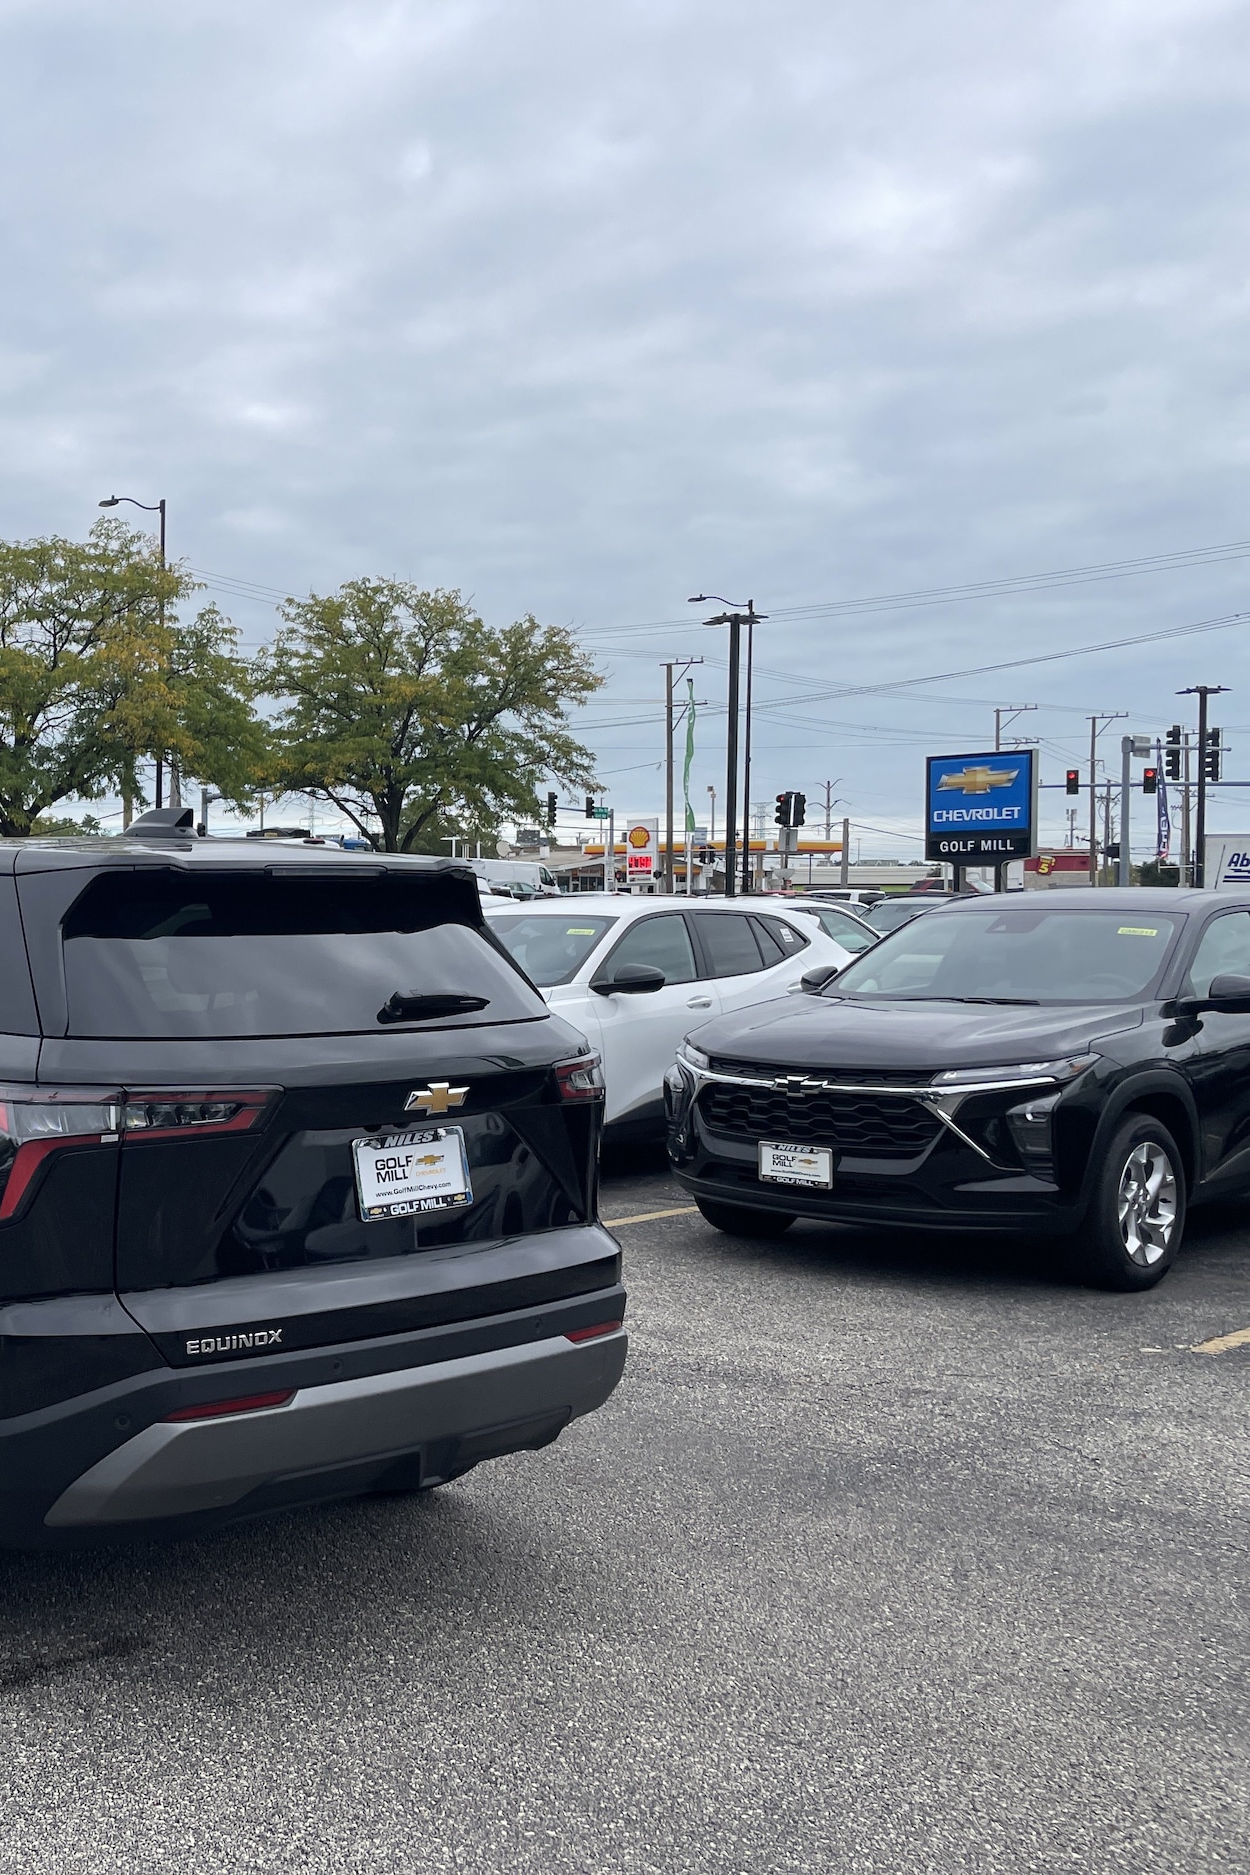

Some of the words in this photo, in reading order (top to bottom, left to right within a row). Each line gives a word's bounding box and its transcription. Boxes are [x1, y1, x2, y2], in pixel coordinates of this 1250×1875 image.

[933, 807, 1021, 822] CHEVROLET
[940, 841, 975, 852] GOLF
[981, 839, 1014, 851] MILL
[383, 1131, 435, 1148] NILES
[375, 1155, 413, 1171] GOLF
[376, 1168, 409, 1183] MILL
[375, 1182, 451, 1198] www.GolfMillChevy.com
[390, 1201, 420, 1215] GOLF
[420, 1197, 447, 1211] MILL
[186, 1328, 283, 1355] EQUINOX
